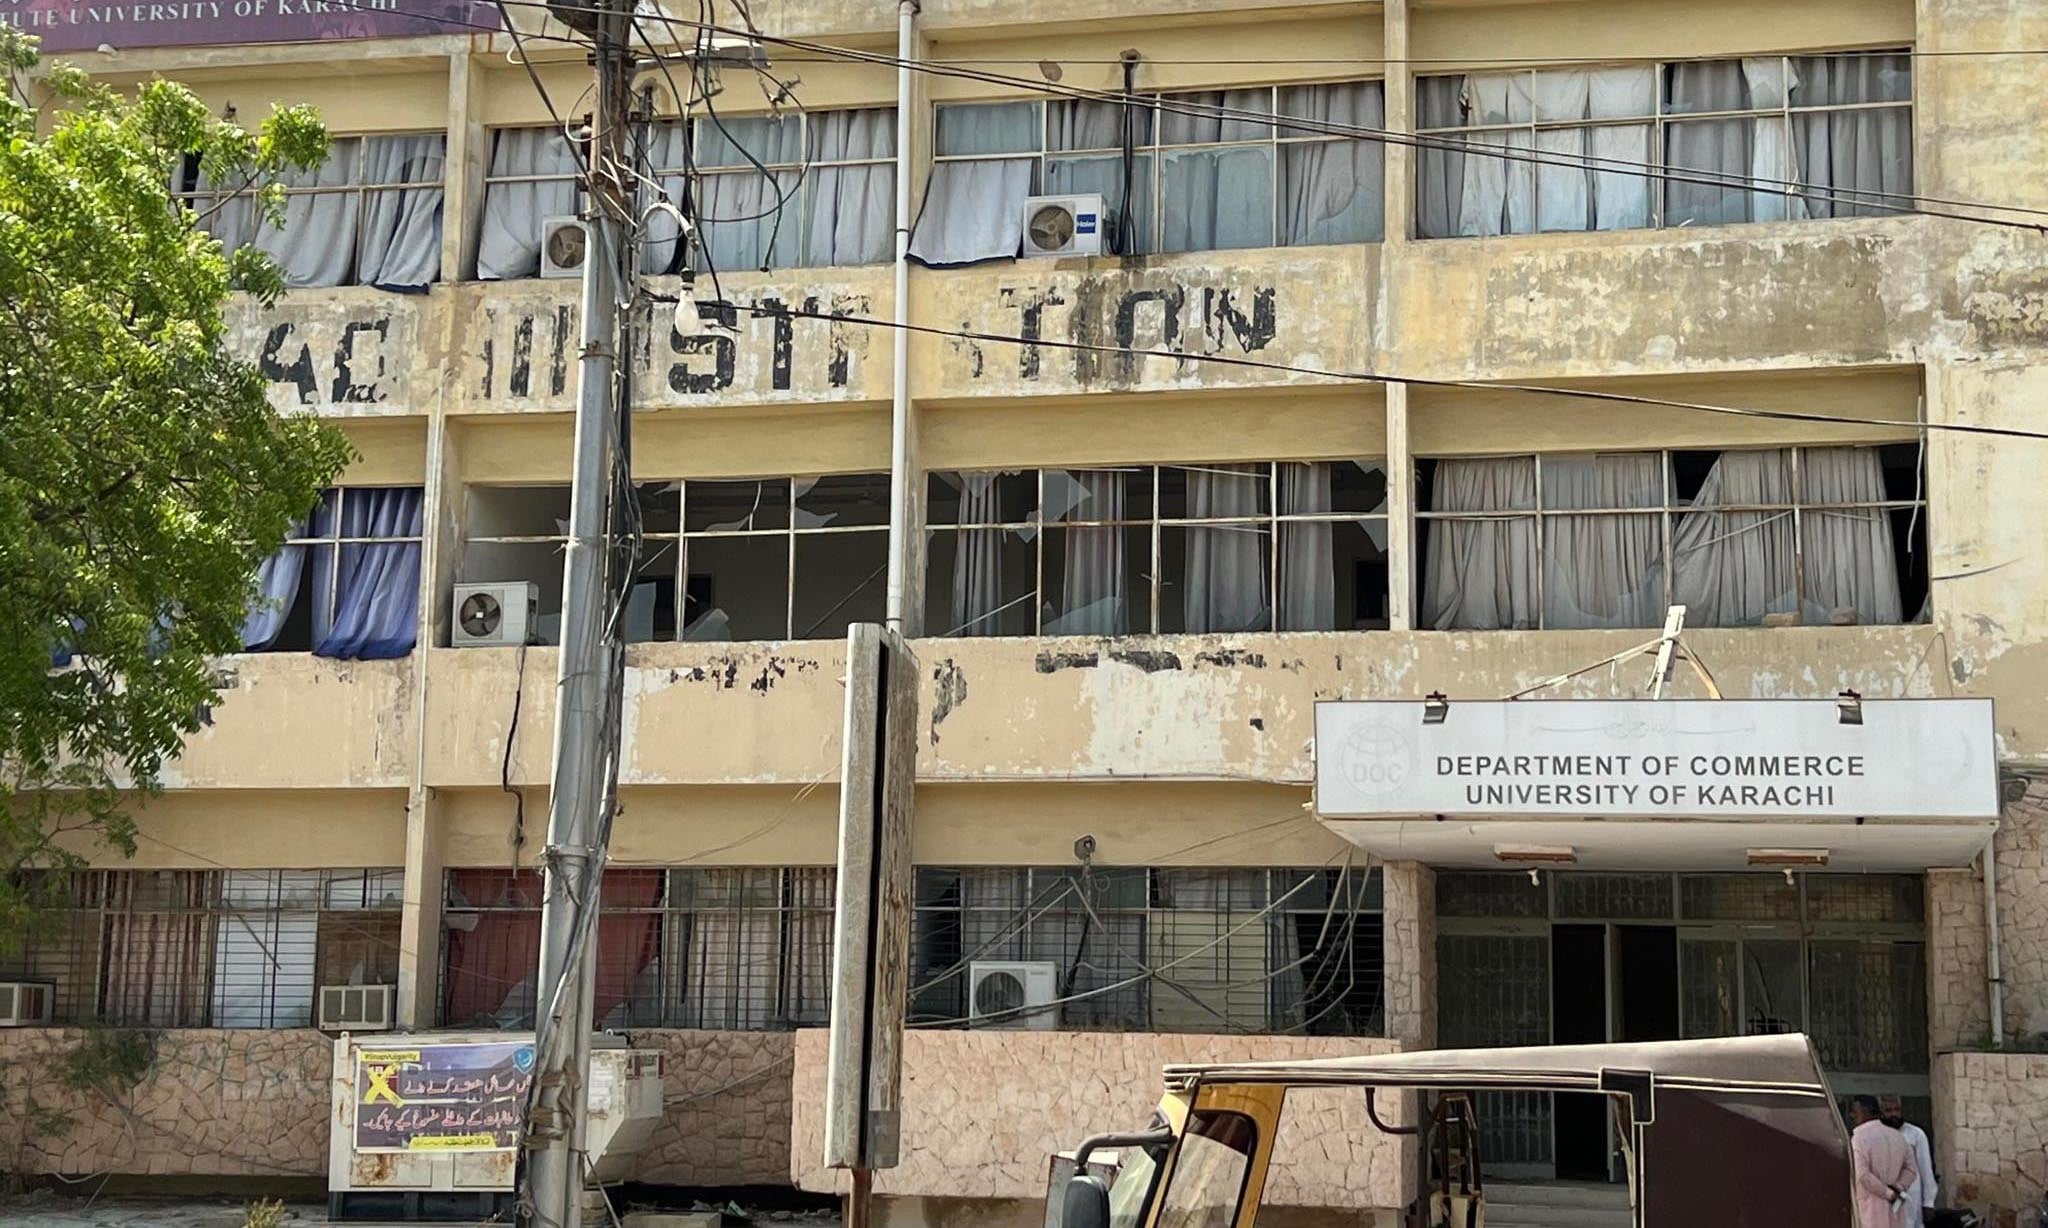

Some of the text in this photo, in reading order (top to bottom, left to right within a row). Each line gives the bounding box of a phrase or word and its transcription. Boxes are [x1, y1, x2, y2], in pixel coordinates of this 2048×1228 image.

[69, 1, 224, 25] UNIVERSITY
[234, 0, 265, 16] OF
[1437, 756, 1864, 777] DEPARTMENT OF COMMERCE
[1466, 785, 1833, 806] UNIVERSITY OF KARACHI
